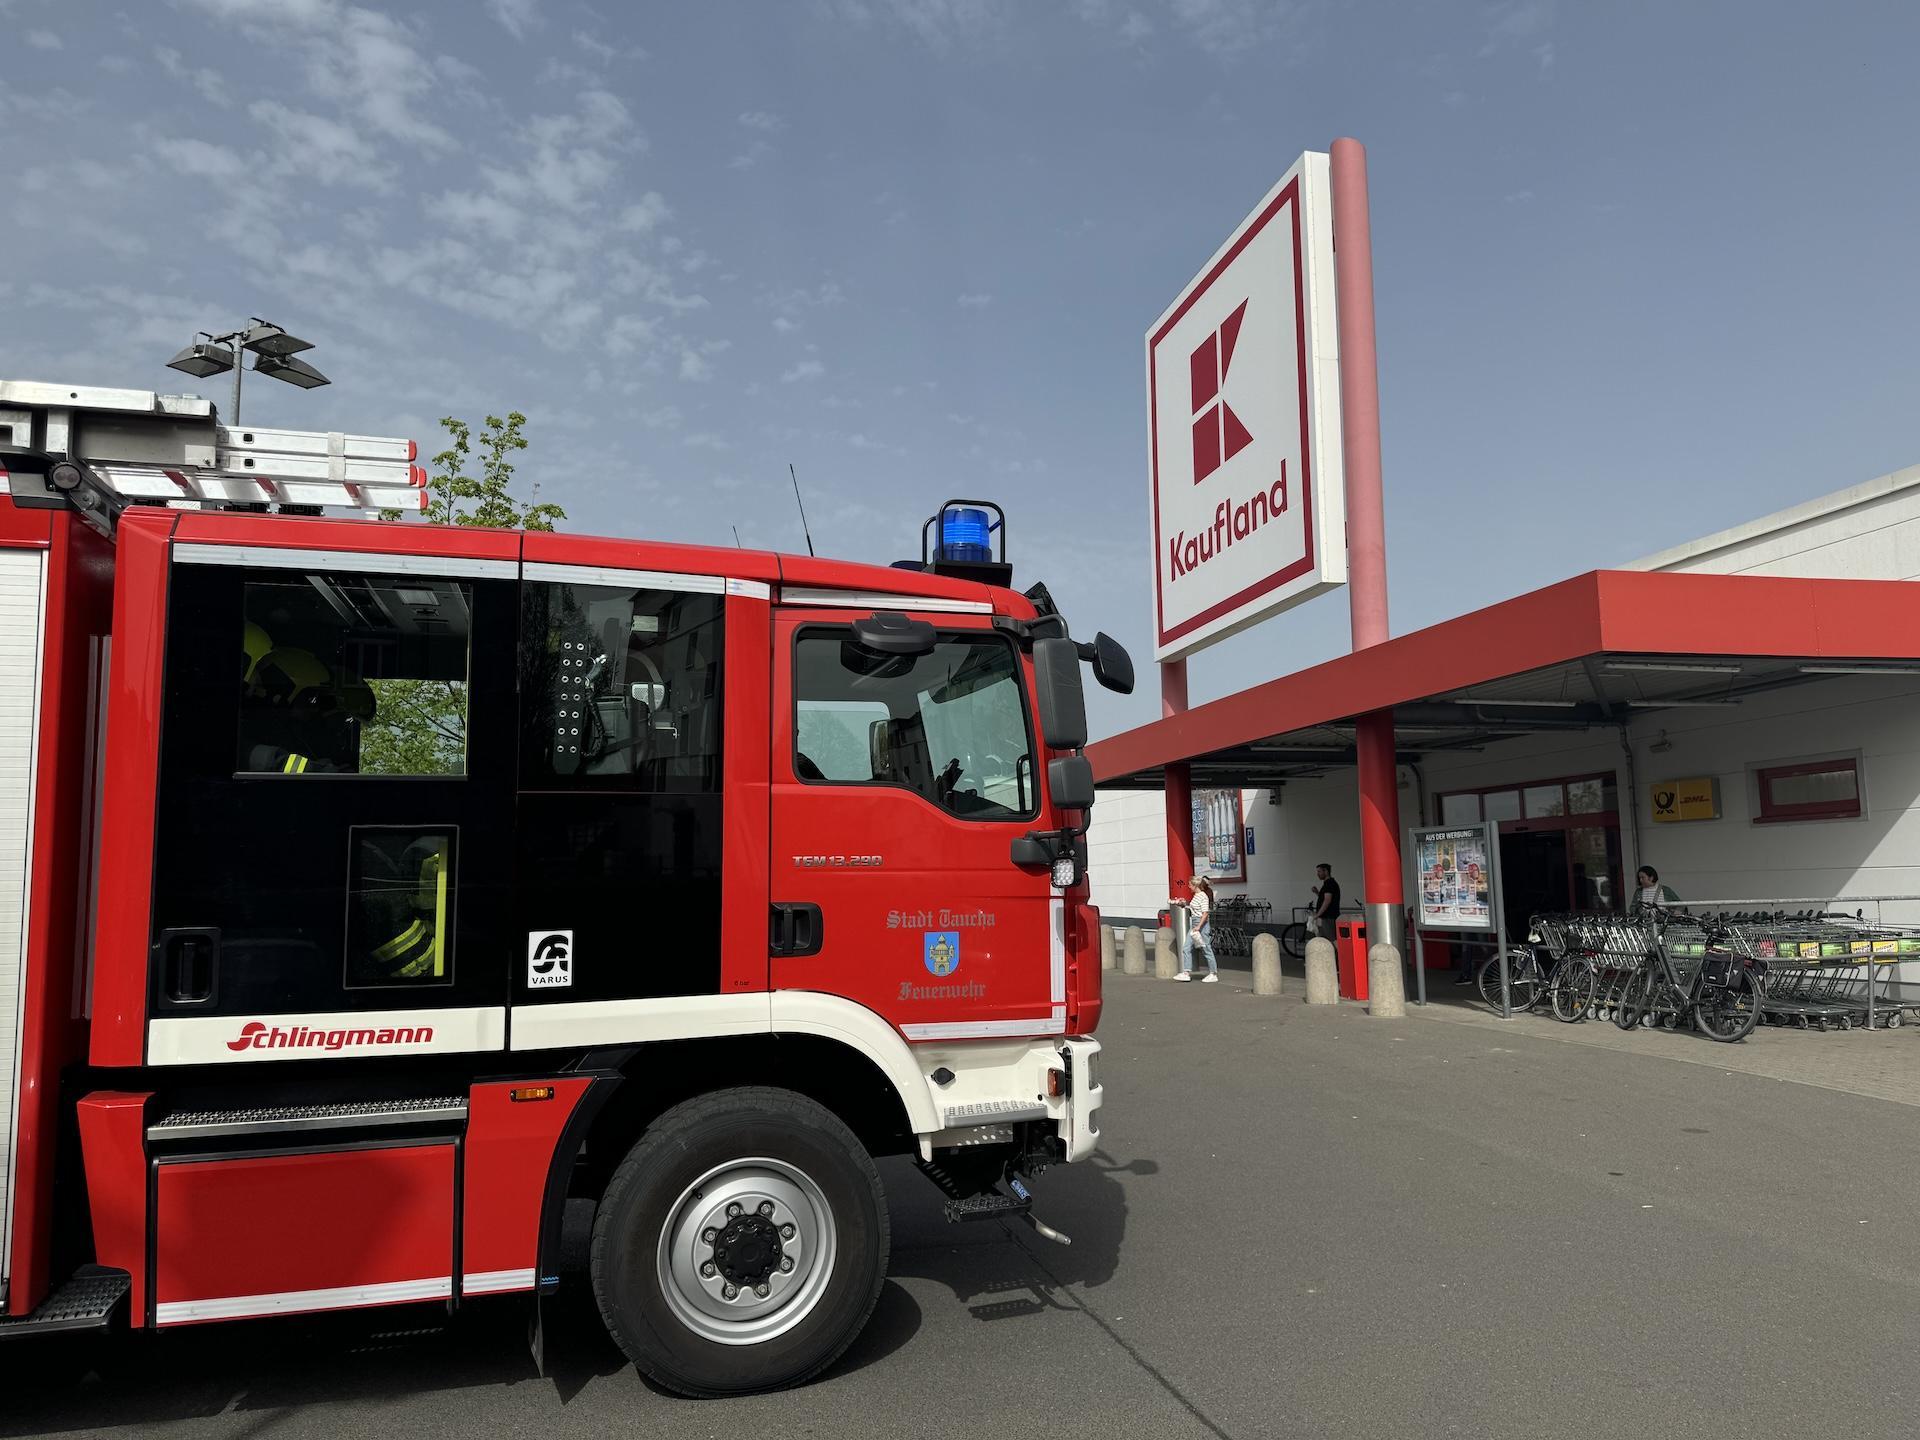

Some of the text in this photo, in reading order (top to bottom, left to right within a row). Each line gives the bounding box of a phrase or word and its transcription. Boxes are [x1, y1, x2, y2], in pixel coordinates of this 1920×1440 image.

[1170, 458, 1288, 583] Kaufland
[792, 855, 883, 867] TGM 13.290
[886, 908, 996, 930] Stadt Taucha
[532, 975, 568, 985] VARUS
[897, 980, 986, 1001] Feuerwehr
[226, 1021, 434, 1052] Schlingmann
